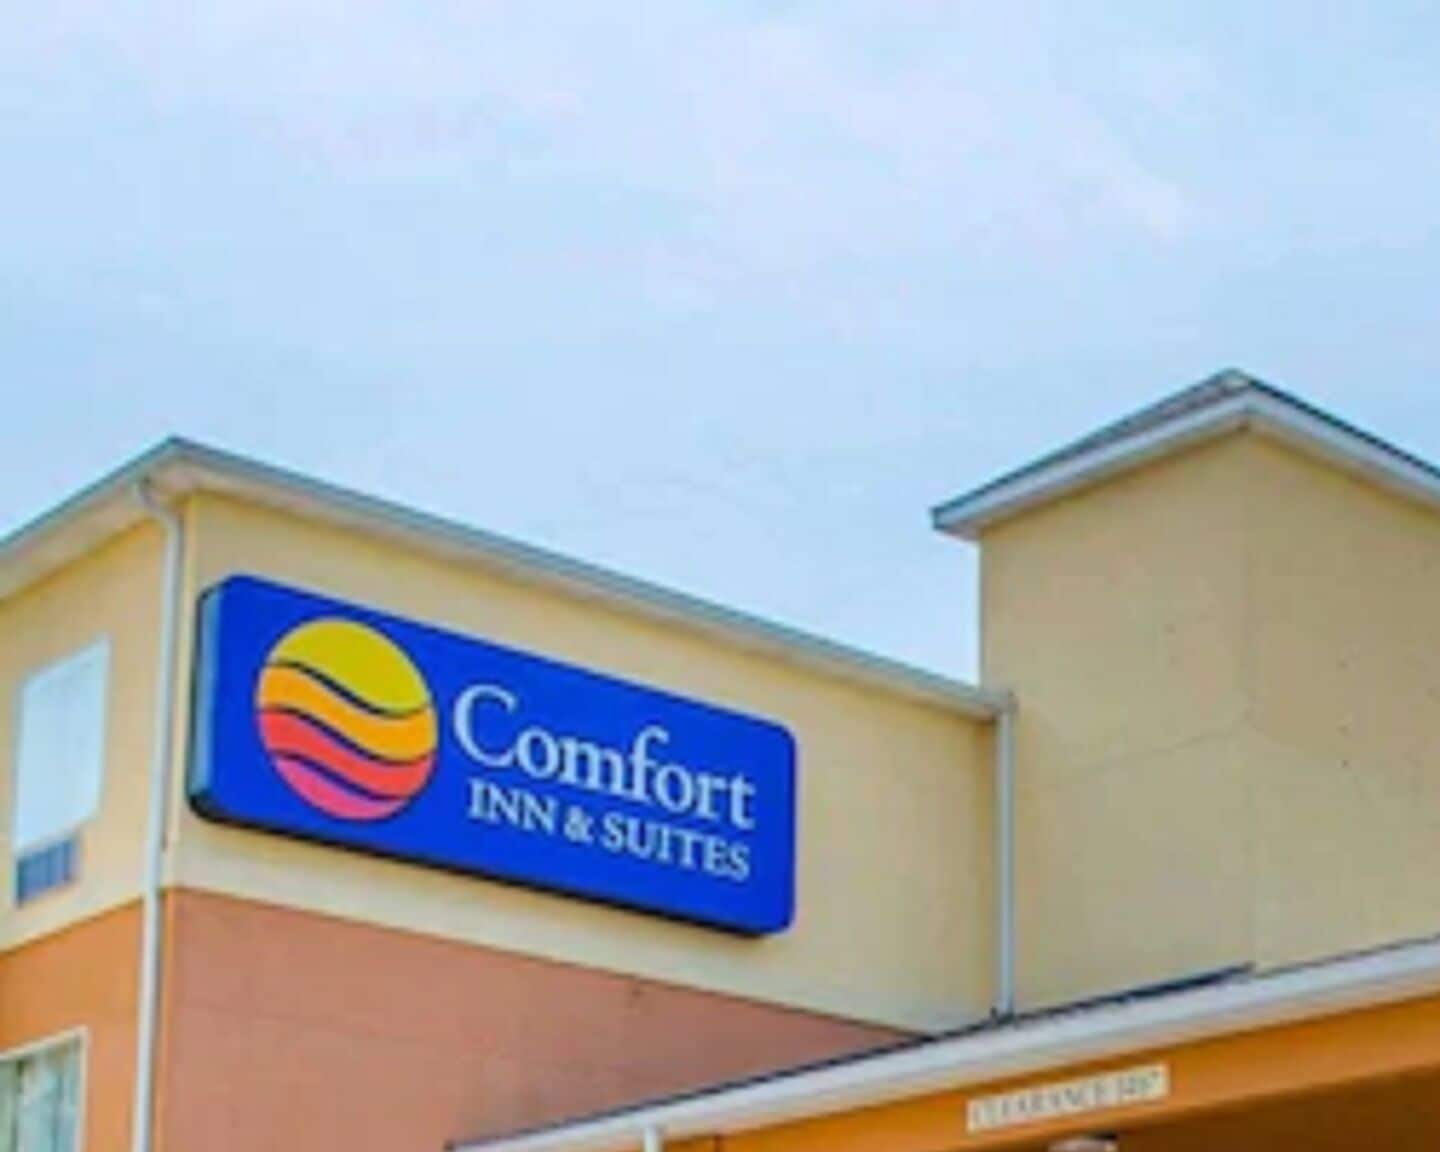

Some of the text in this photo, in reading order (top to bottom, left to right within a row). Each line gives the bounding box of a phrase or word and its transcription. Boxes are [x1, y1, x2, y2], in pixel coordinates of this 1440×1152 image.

[453, 684, 756, 830] Comfort
[468, 778, 751, 882] INN & SUITES
